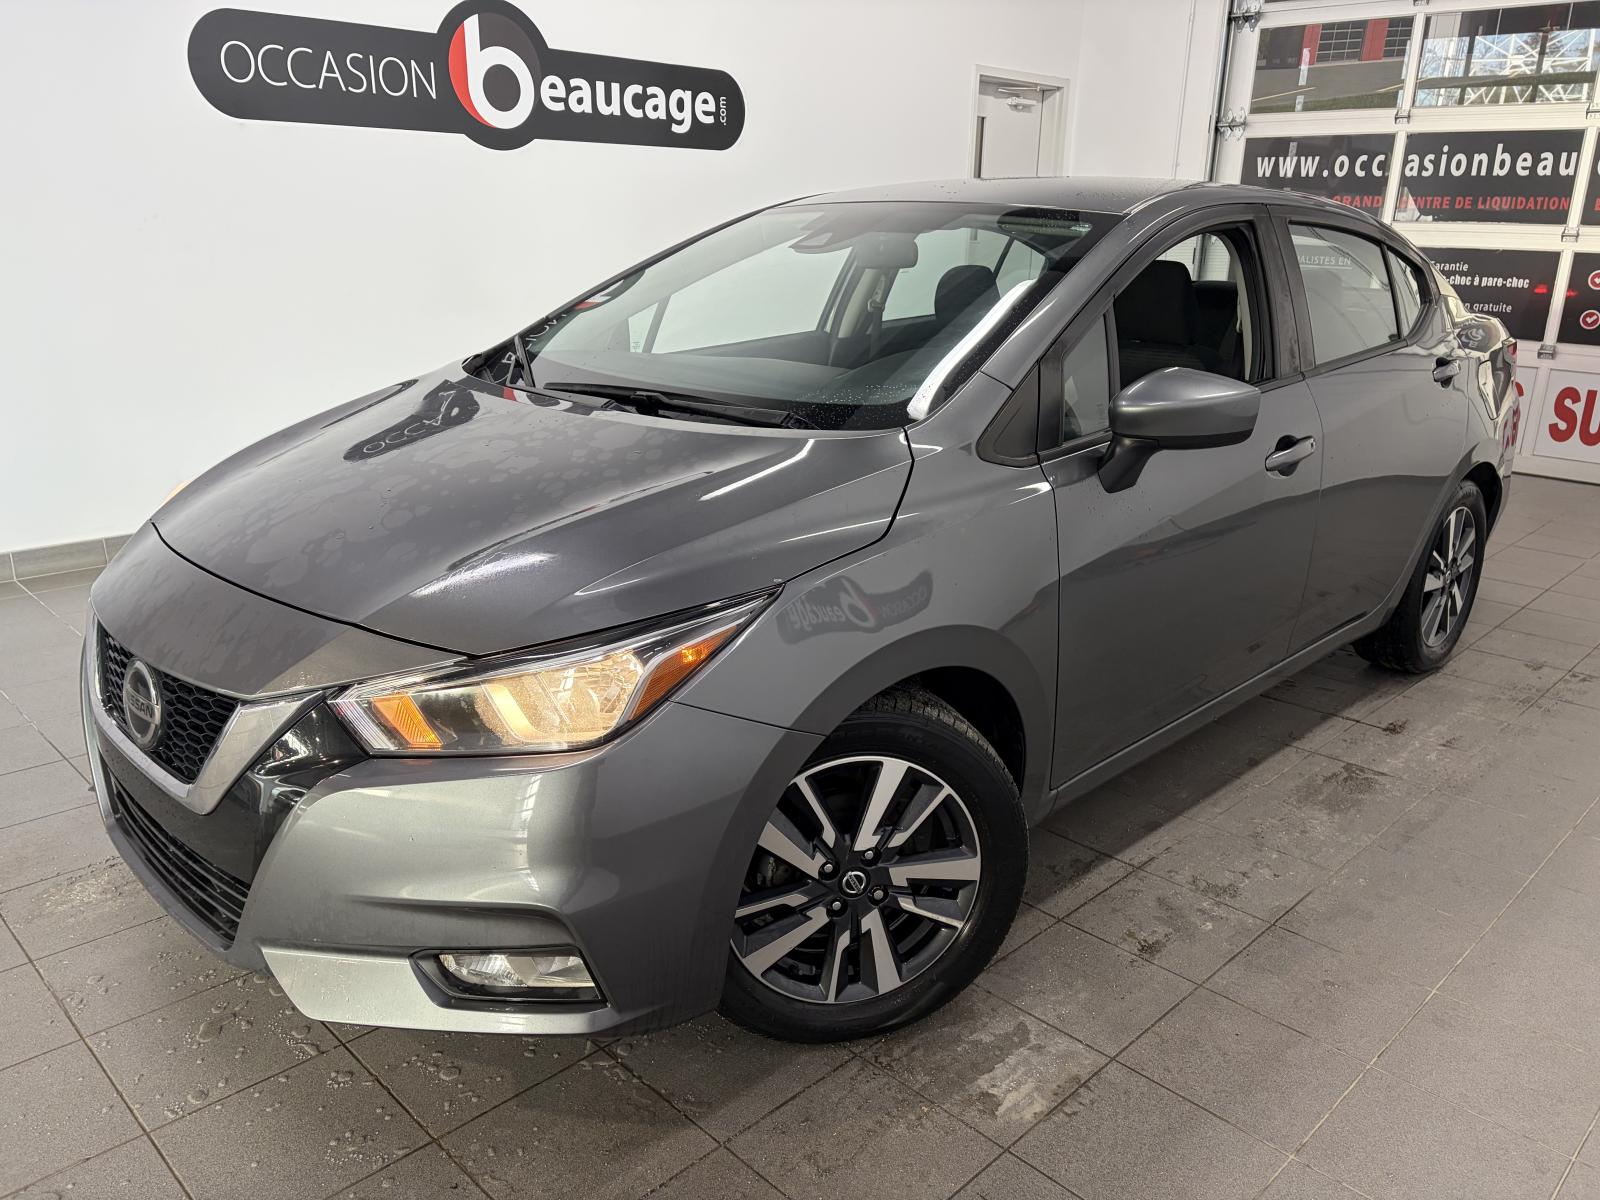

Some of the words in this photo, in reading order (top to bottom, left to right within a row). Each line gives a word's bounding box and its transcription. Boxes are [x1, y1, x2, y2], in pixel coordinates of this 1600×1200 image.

[219, 39, 437, 99] OCCASION
[1256, 143, 1600, 178] www.occasionbeau
[1398, 195, 1452, 210] CNTRE
[1455, 196, 1473, 210] DE
[1473, 275, 1480, 286] à
[1481, 276, 1530, 289] pare-choc
[1473, 302, 1512, 313] gratuite
